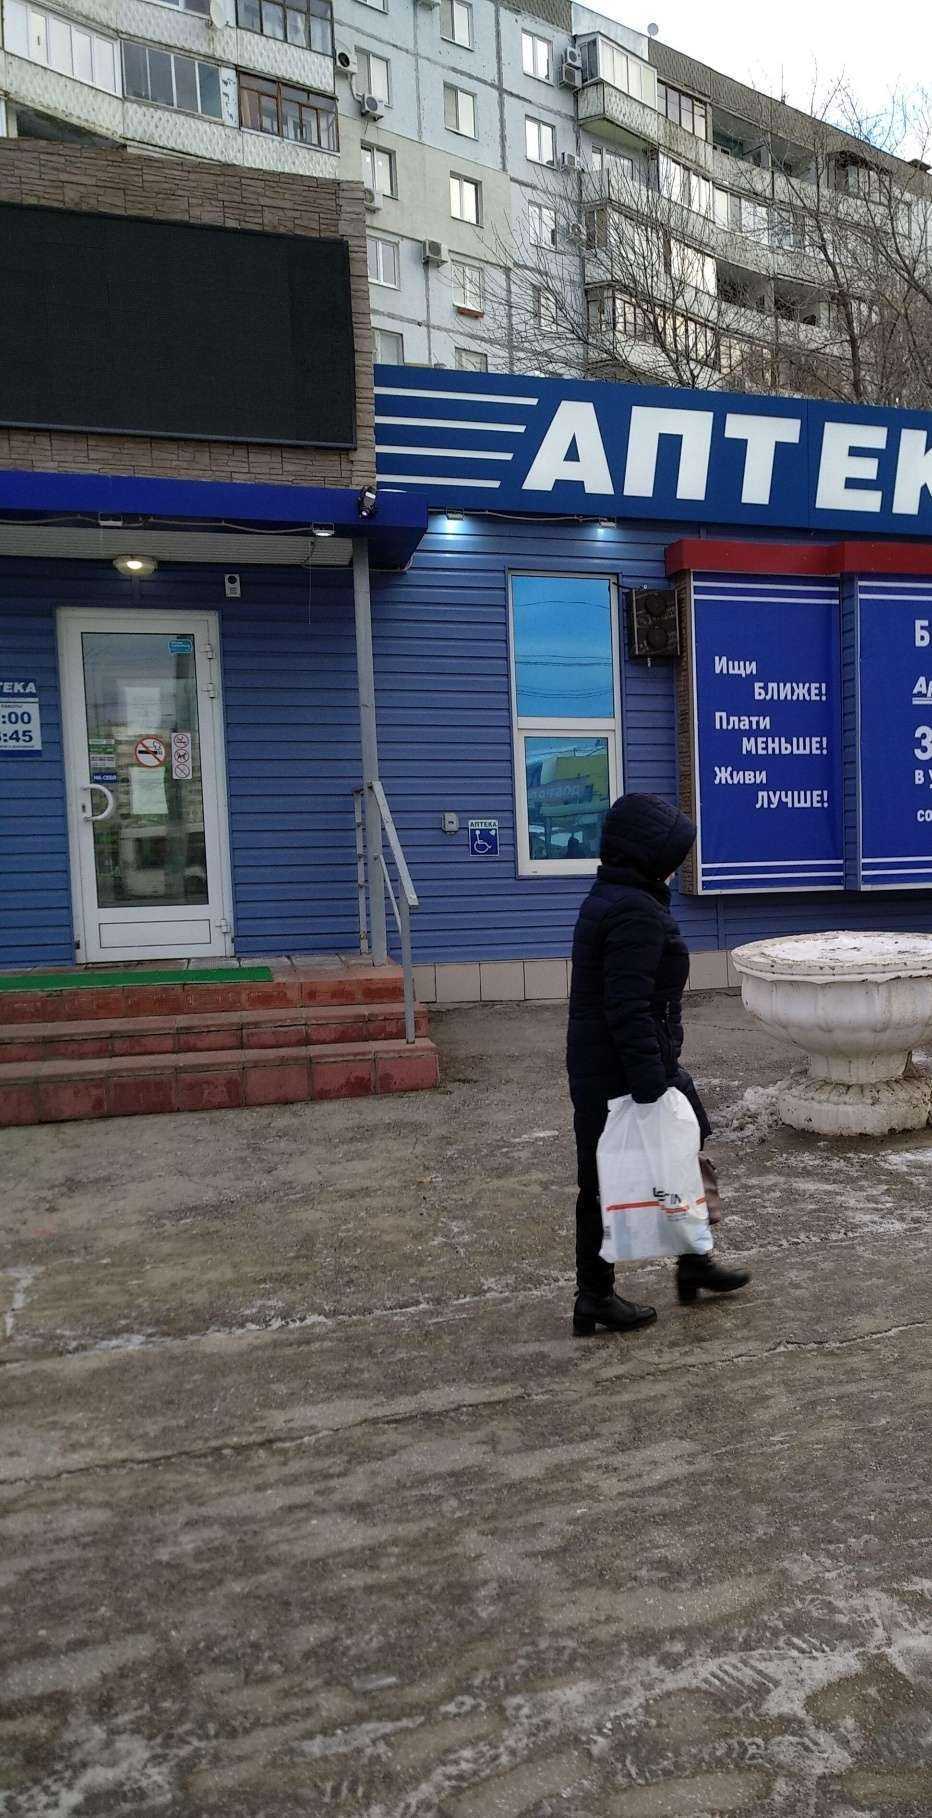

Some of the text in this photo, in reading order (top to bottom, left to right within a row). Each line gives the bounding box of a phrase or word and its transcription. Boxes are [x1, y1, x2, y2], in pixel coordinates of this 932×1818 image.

[714, 655, 757, 677] Ищи
[754, 682, 827, 701] БЛИЖЕ!
[714, 711, 771, 730] Плати
[742, 736, 828, 755] МЕНЬШЕ!
[714, 766, 767, 785] Живи
[755, 790, 829, 808] ЛУЧШЕ!
